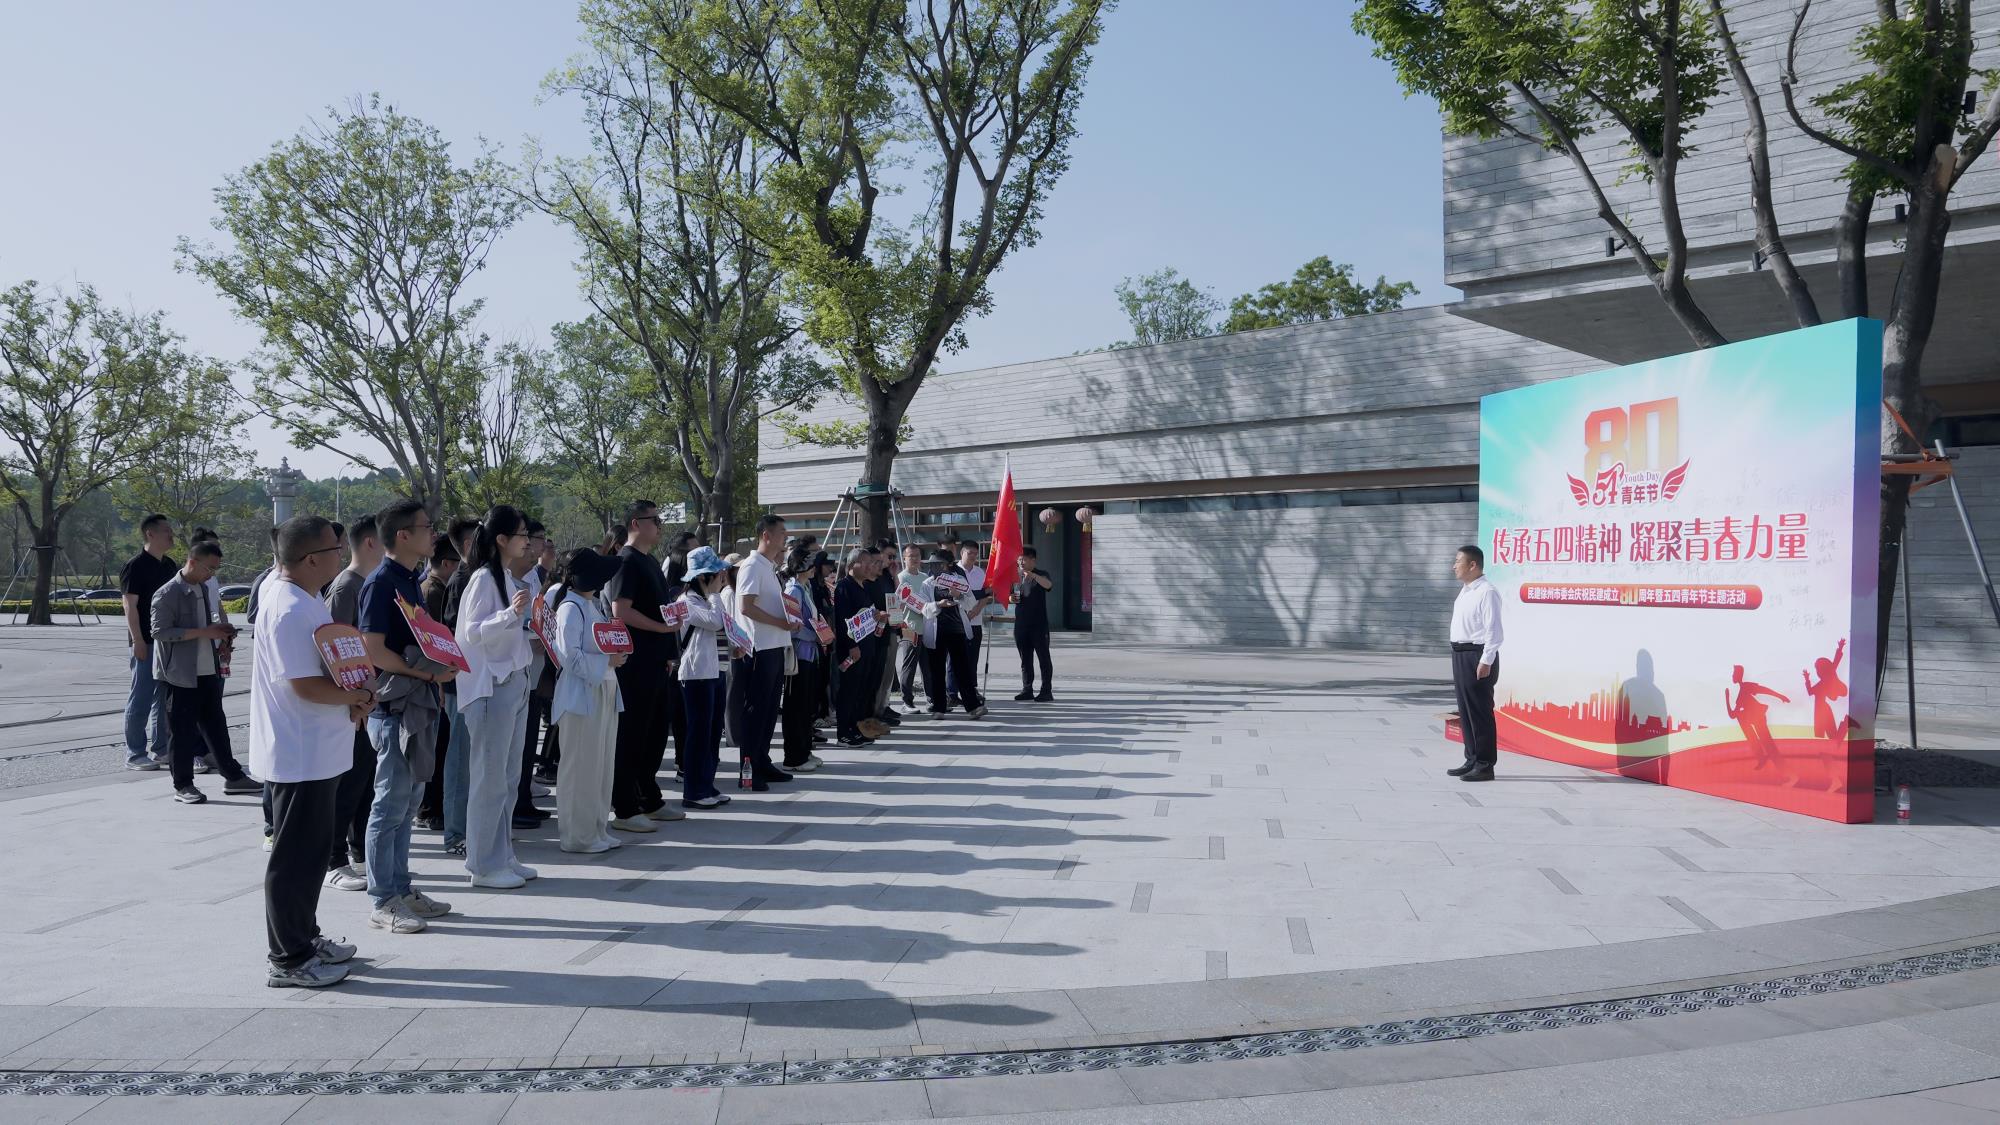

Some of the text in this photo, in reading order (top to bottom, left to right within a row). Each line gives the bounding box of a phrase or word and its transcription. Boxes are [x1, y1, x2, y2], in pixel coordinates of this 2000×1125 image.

[1584, 397, 1679, 485] 80
[1621, 483, 1659, 505] 青年节
[1624, 471, 1660, 483] Youth Day
[1492, 522, 1622, 564] 传承五四精神
[1629, 512, 1809, 563] 凝聚青春力量
